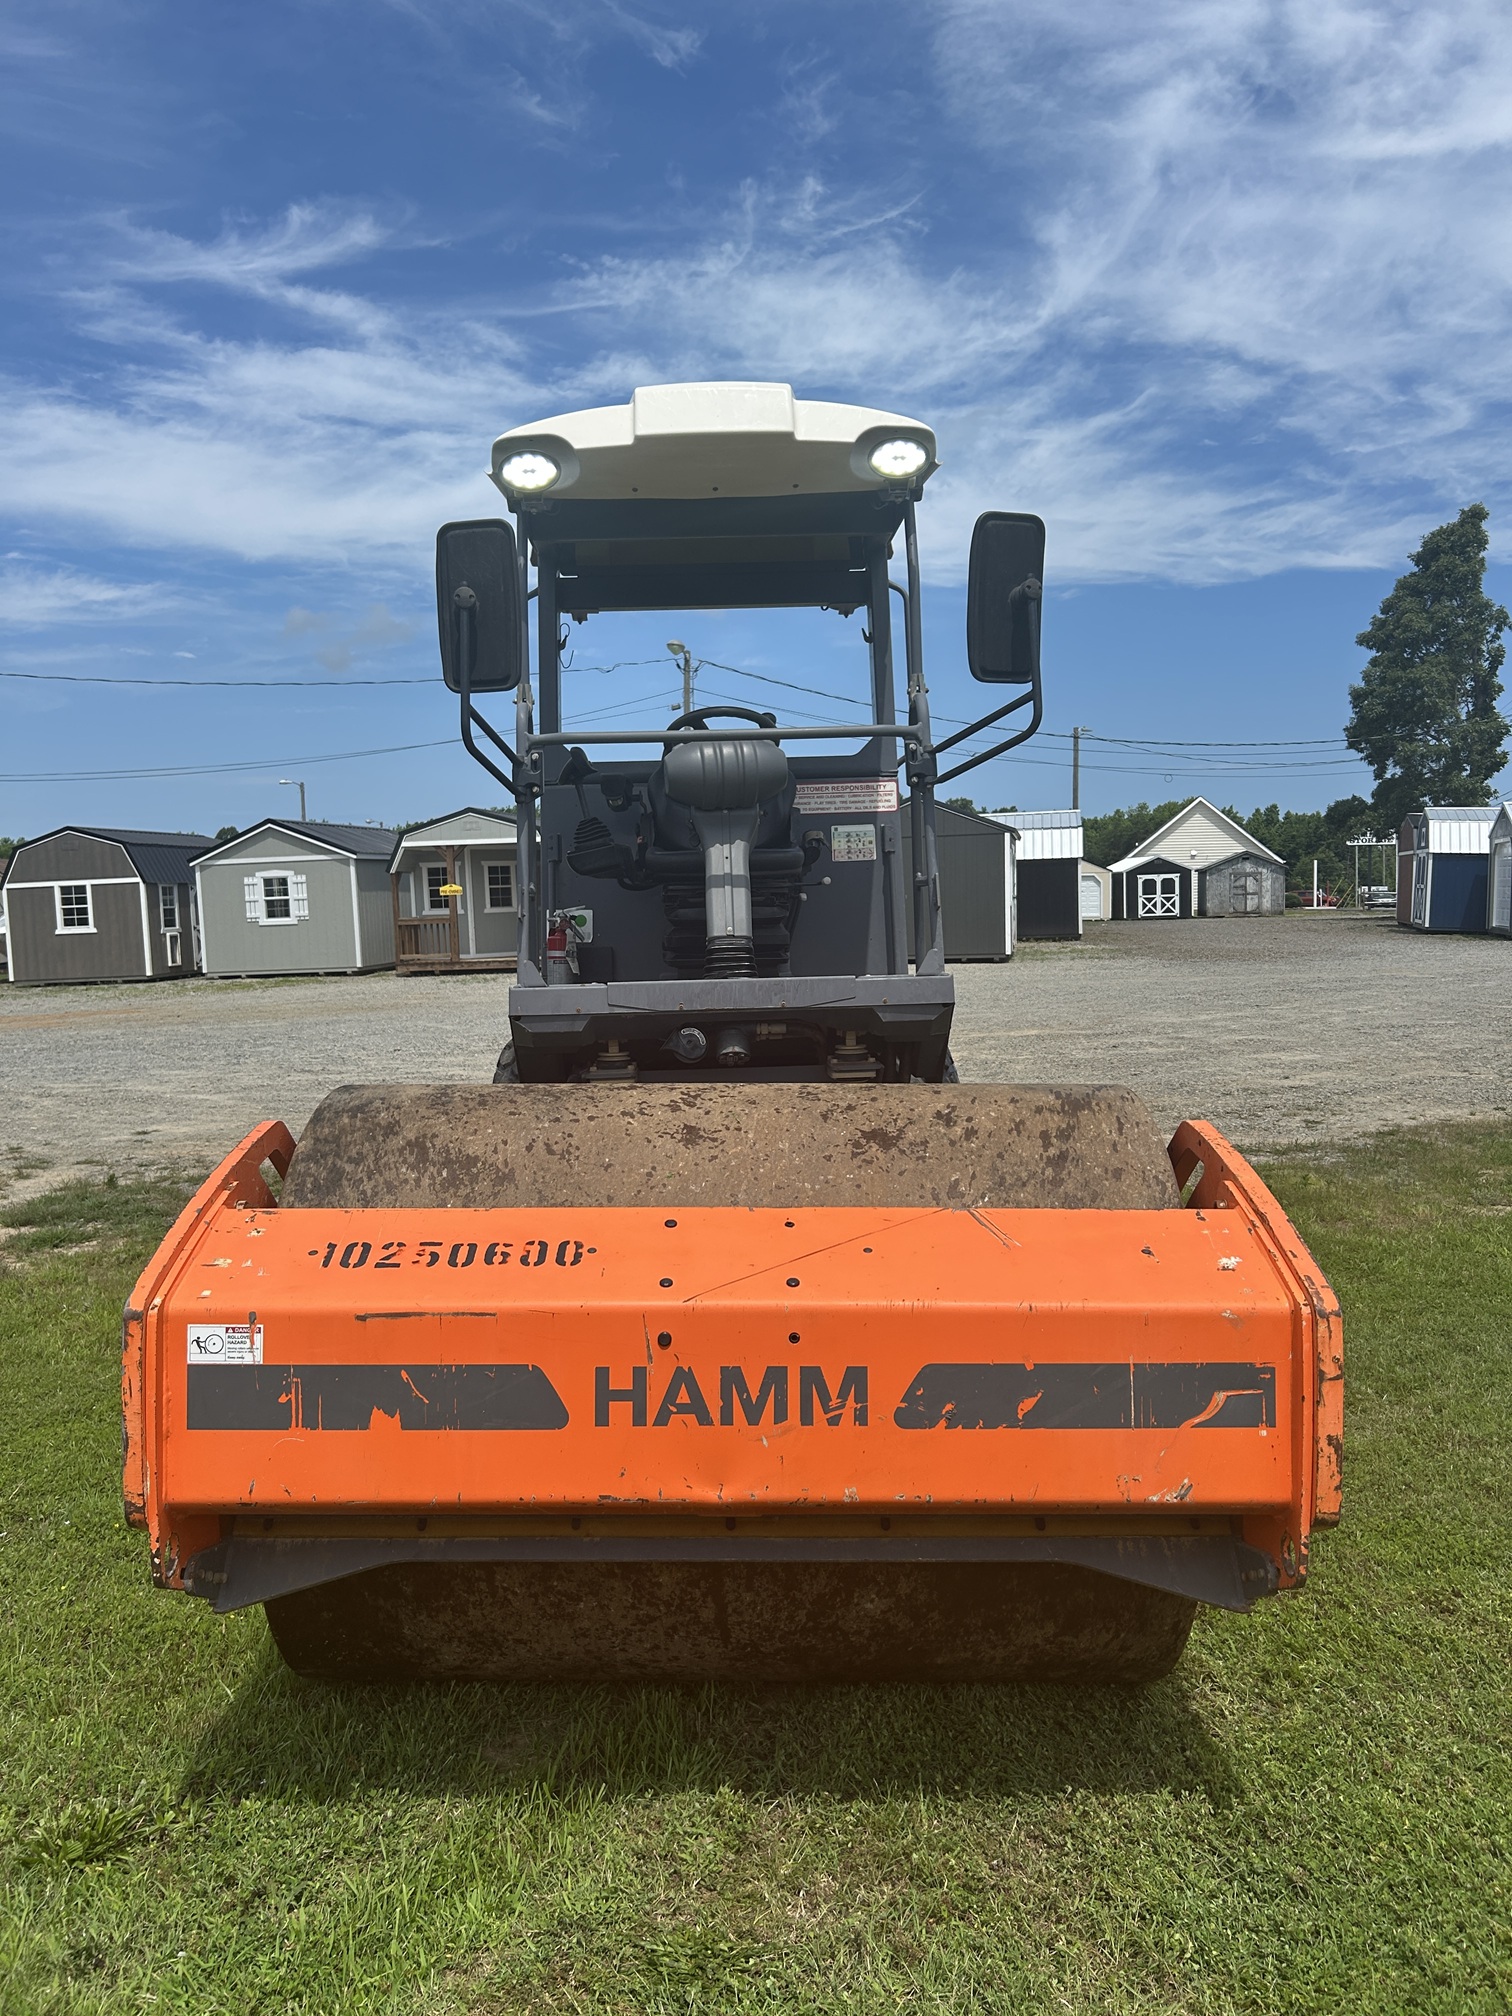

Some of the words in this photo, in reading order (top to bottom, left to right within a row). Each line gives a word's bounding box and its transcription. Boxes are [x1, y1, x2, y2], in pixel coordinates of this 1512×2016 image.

[796, 785, 830, 793] USTOMER
[831, 784, 887, 792] RESPONSIBILITY
[594, 1365, 869, 1427] HAMM
